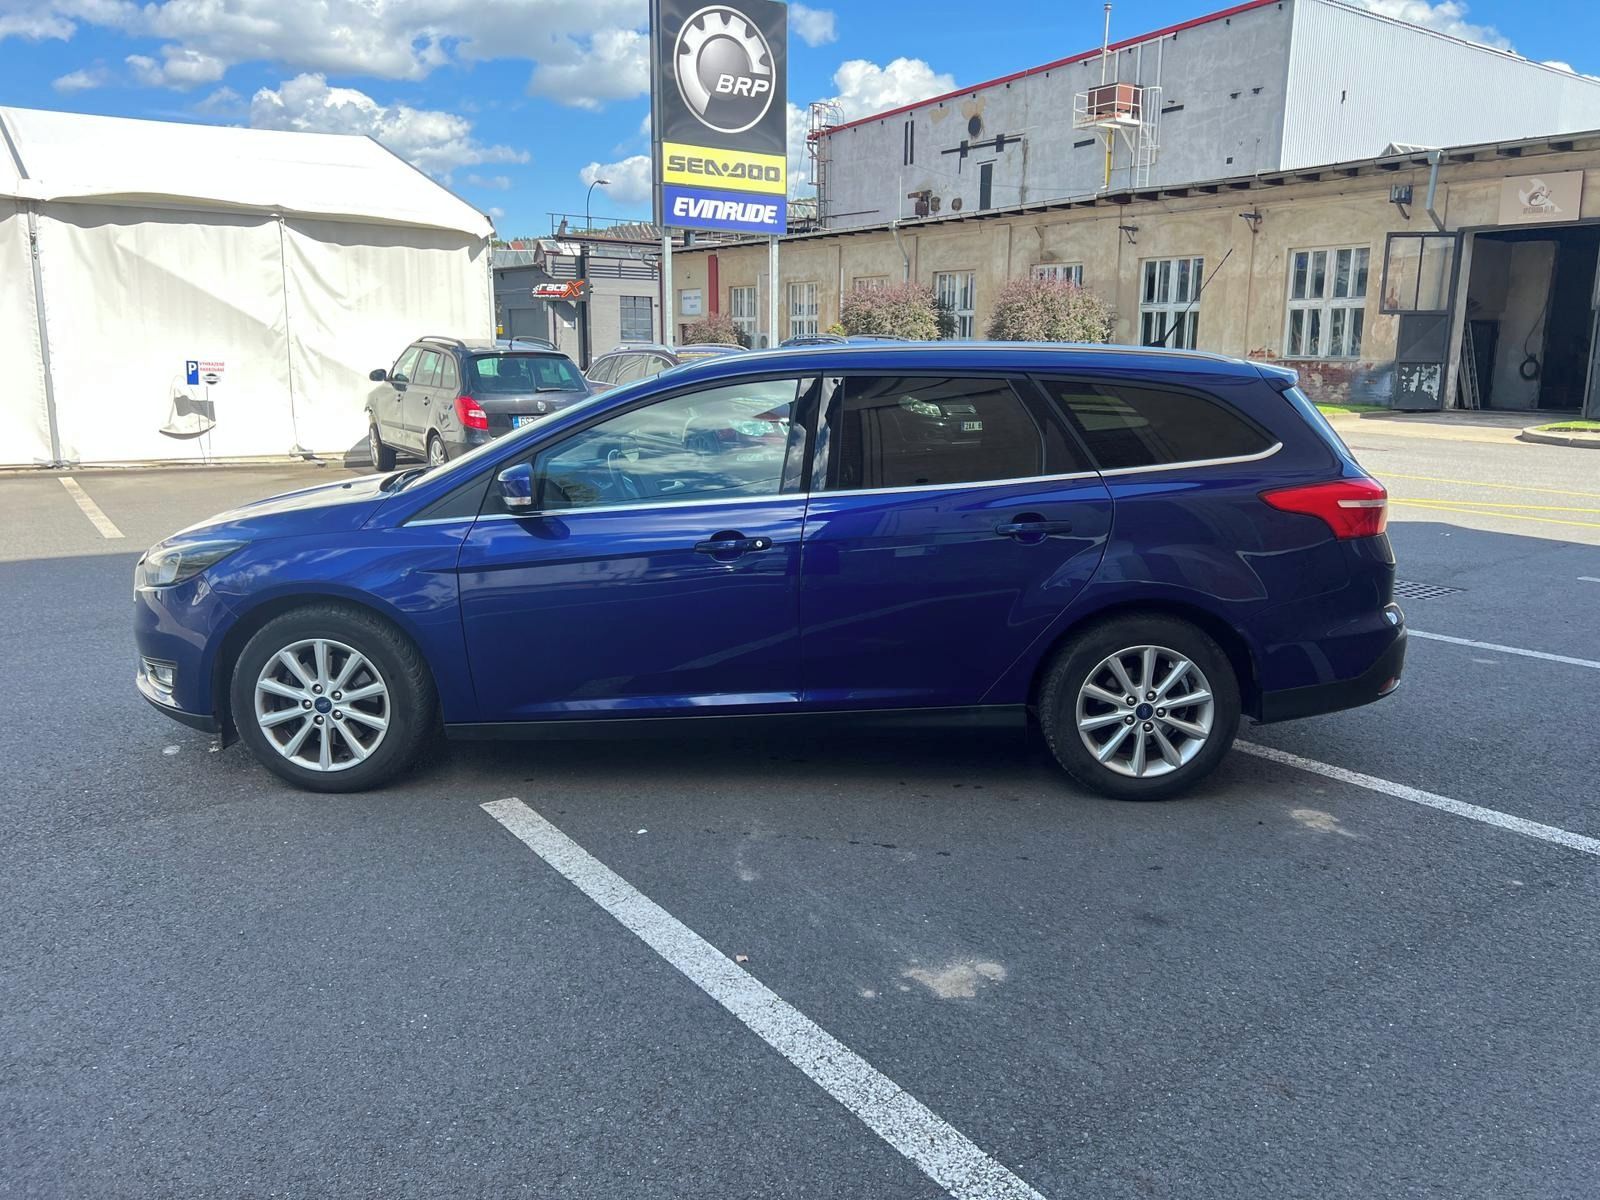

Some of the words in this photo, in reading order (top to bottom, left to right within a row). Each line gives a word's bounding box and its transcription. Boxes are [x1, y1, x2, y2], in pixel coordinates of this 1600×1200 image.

[715, 73, 770, 97] BRP
[672, 196, 778, 224] EVINRUDE
[187, 362, 197, 374] P
